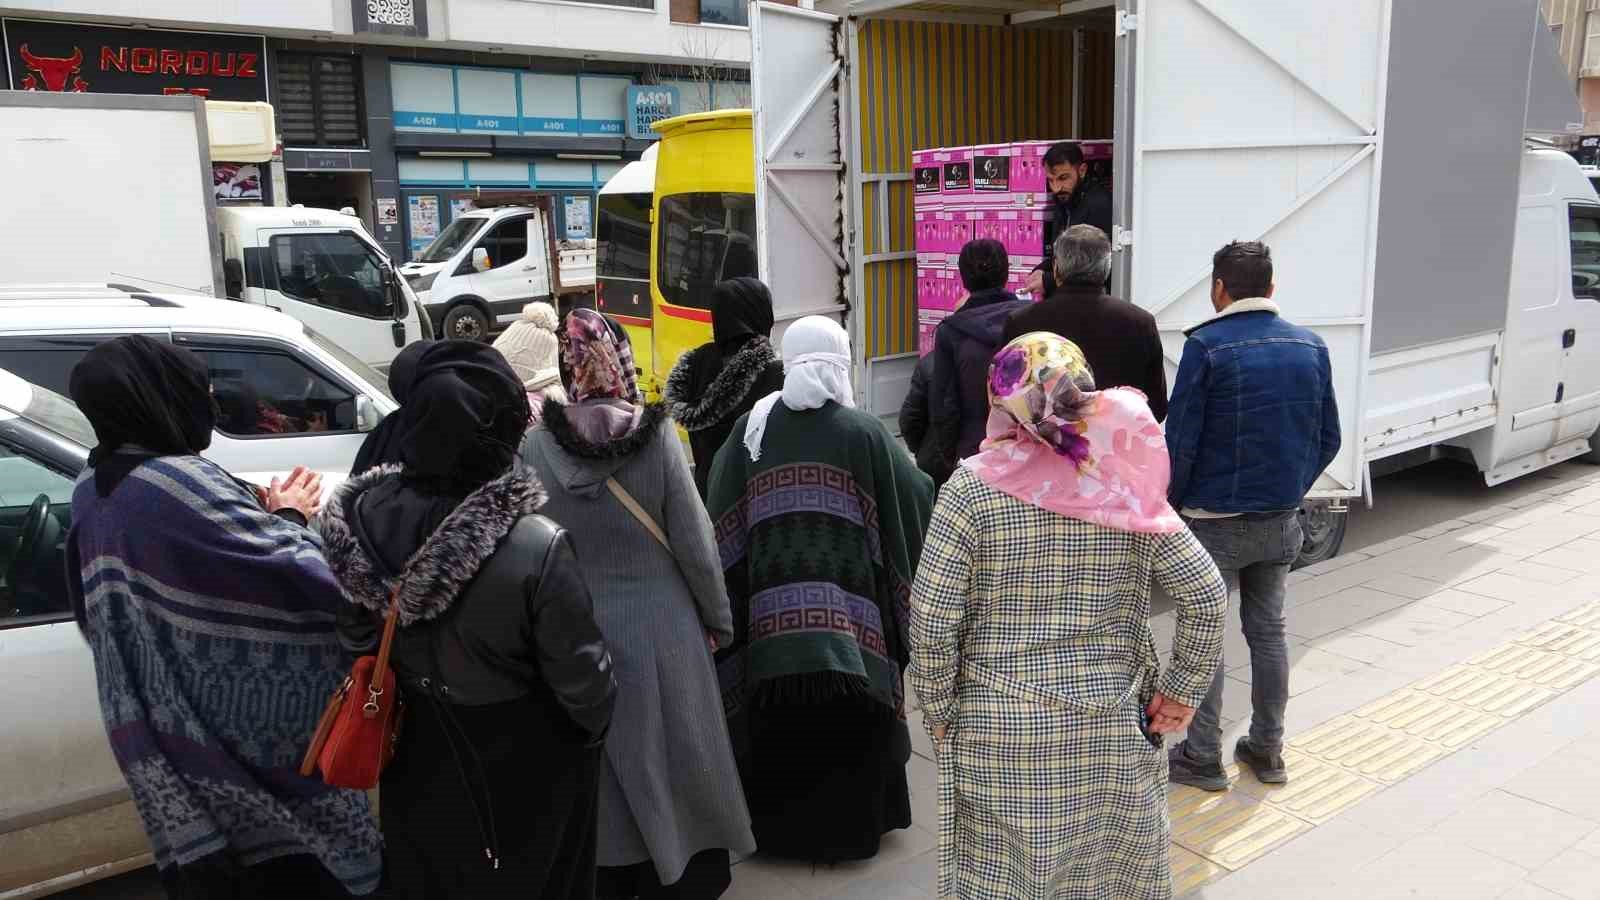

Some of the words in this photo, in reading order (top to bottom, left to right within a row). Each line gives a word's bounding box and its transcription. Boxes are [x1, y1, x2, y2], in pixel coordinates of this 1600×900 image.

[100, 46, 257, 78] NORDUZ
[636, 91, 672, 105] A101
[412, 116, 437, 126] A101
[476, 119, 500, 129] A101
[543, 121, 565, 130] A101
